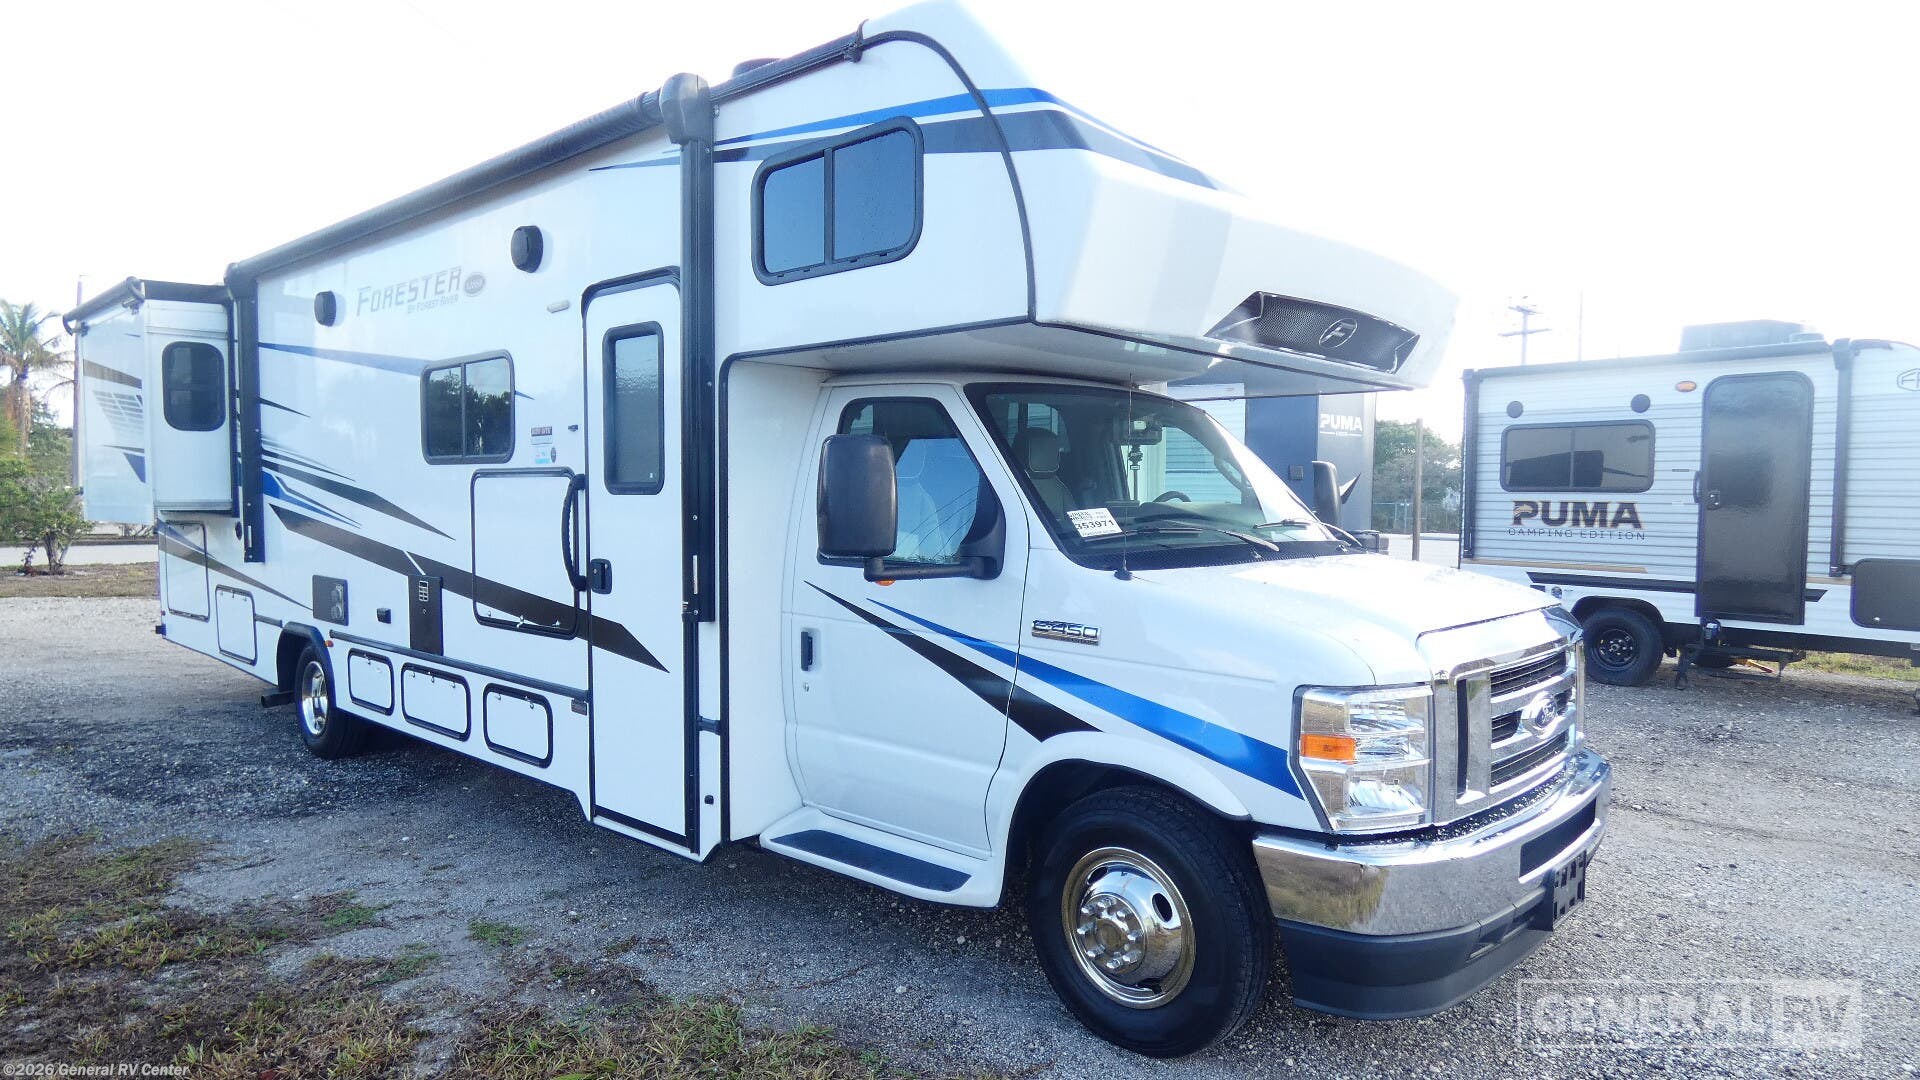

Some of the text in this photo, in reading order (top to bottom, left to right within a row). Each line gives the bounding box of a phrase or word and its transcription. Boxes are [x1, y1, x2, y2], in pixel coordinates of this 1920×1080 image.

[357, 265, 462, 317] FORESTER
[1320, 413, 1363, 432] PUMA
[1512, 500, 1643, 529] PUMA
[1075, 520, 1115, 530] 353971
[1508, 528, 1646, 541] CAMPING EDITION
